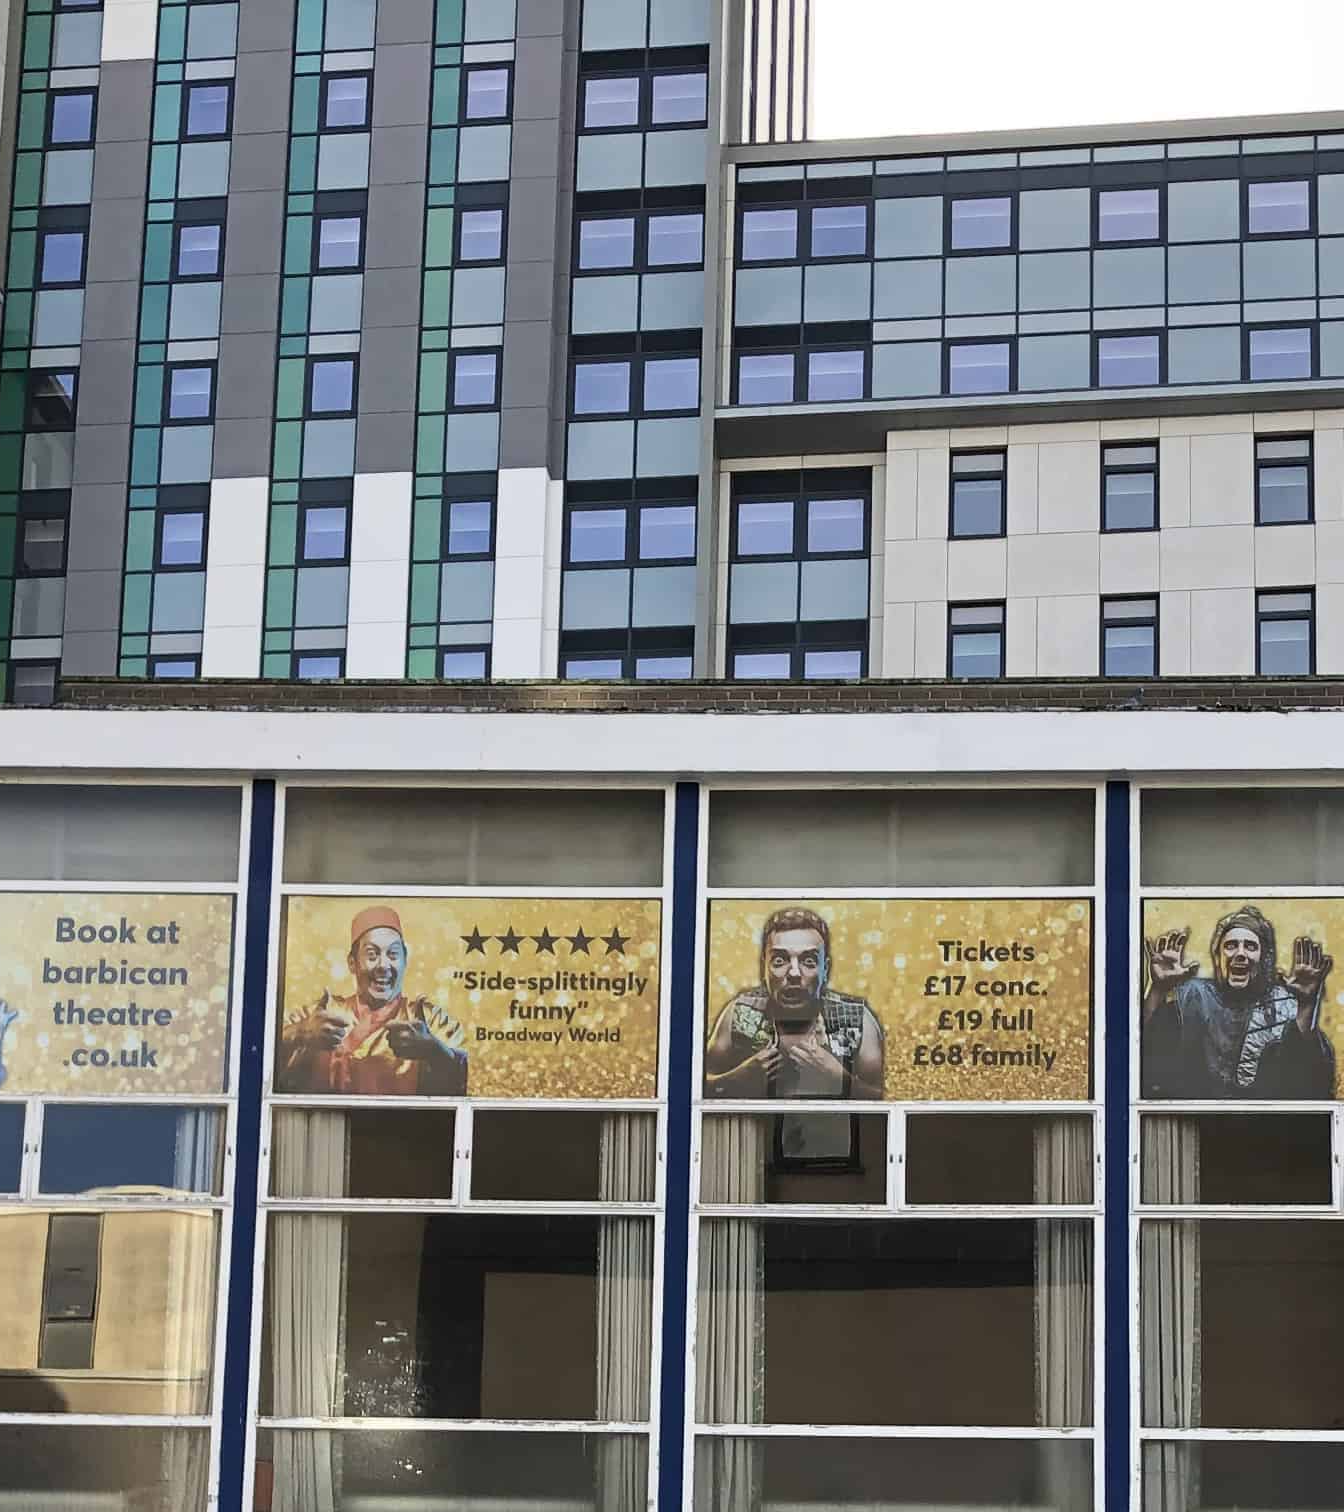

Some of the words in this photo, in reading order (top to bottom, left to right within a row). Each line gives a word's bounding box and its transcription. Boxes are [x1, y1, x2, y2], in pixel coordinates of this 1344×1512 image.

[56, 917, 136, 944] Book
[147, 920, 180, 945] at
[938, 940, 1036, 962] Tickets
[43, 958, 188, 985] barbican
[924, 975, 967, 996] £17
[974, 979, 1049, 997] conc.
[53, 999, 173, 1026] theatre
[937, 1009, 983, 1031] £19
[991, 1008, 1034, 1031] full
[476, 1027, 564, 1046] Broadway
[568, 1027, 622, 1043] World
[63, 1040, 158, 1068] .co.uk
[913, 1044, 964, 1066] £68
[971, 1043, 1057, 1071] family
